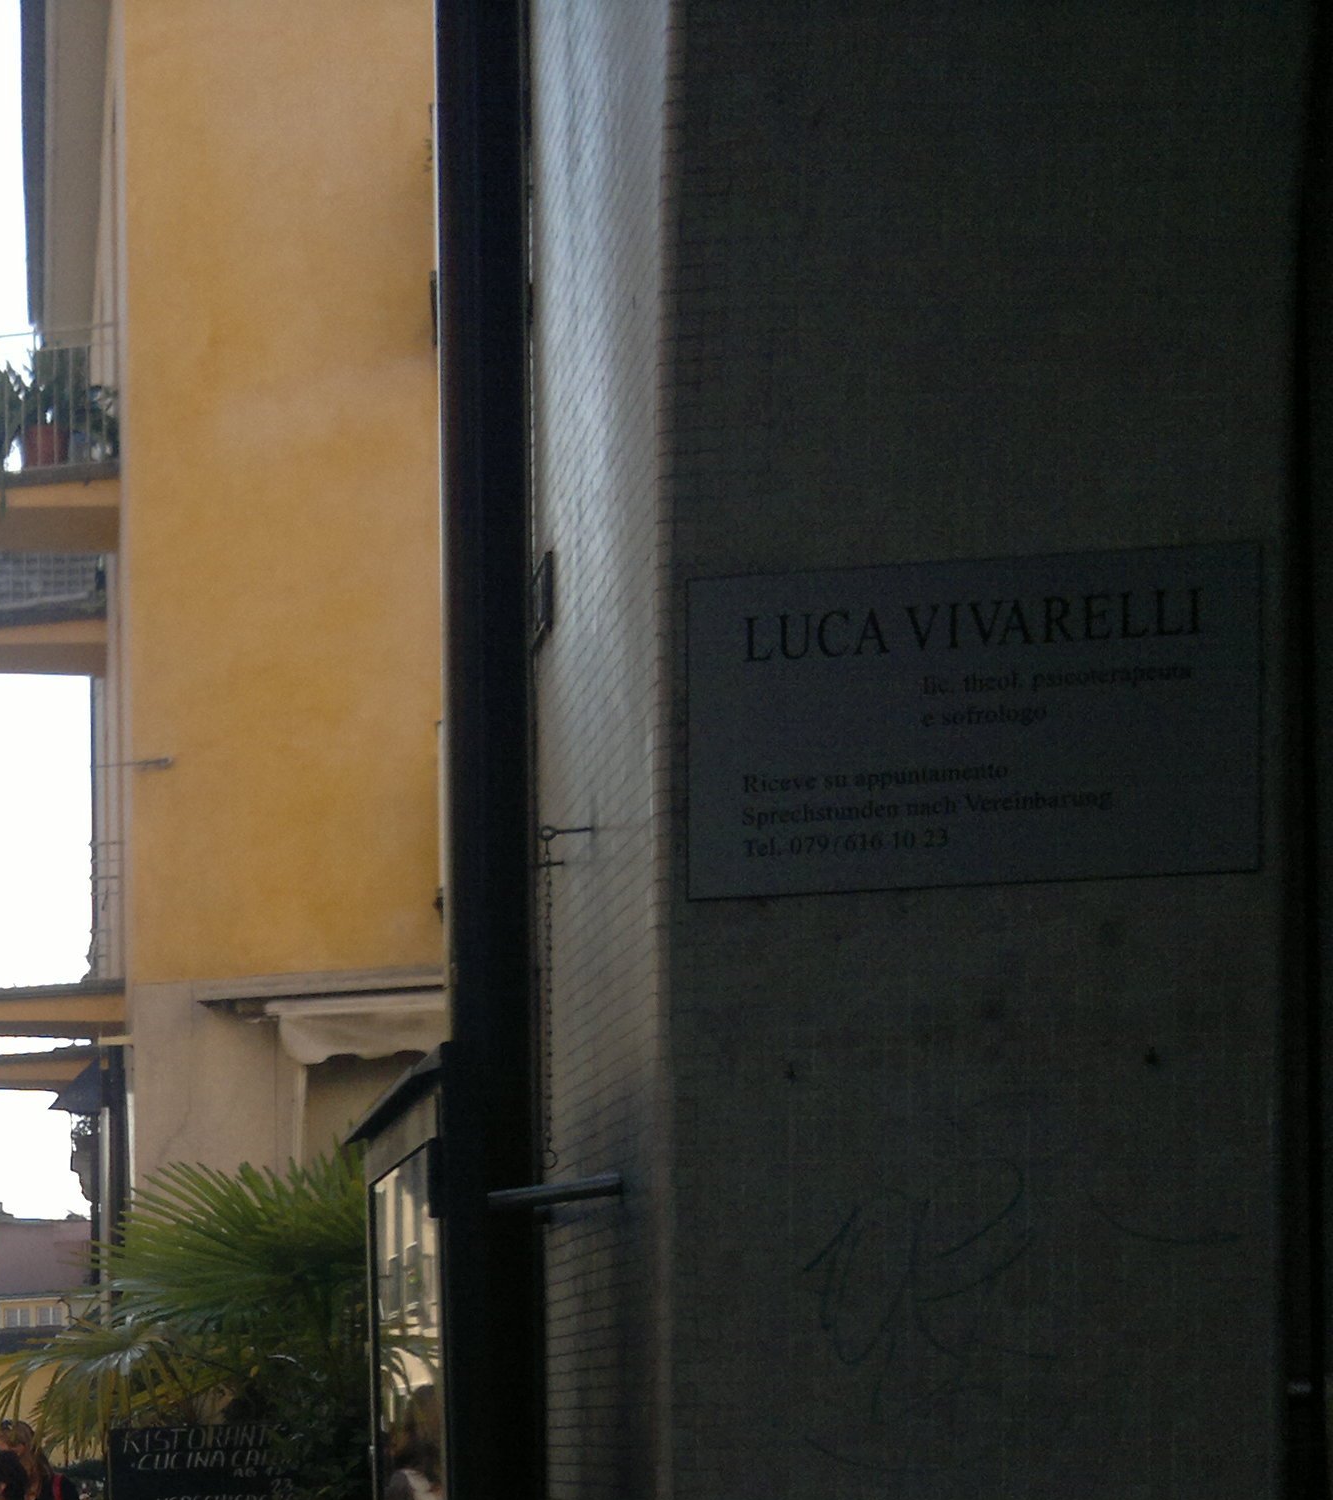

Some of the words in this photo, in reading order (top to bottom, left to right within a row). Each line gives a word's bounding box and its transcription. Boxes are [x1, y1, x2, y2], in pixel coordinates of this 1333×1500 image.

[743, 606, 890, 662] LUCA
[905, 586, 1204, 651] VIVARELLI
[963, 671, 1024, 693] theol.
[1031, 663, 1192, 691] psicoterapeuta
[941, 703, 1048, 727] sofrologo
[742, 774, 818, 794] Riceve
[824, 774, 848, 789] su
[854, 763, 1009, 790] appuntamento
[741, 797, 899, 829] Sprechstunden
[906, 796, 957, 818] nach
[965, 788, 1113, 815] Vereinbarung
[743, 837, 783, 859] Tel.
[892, 830, 916, 850] 10
[922, 827, 950, 849] 23
[136, 1450, 226, 1471] CUCINA
